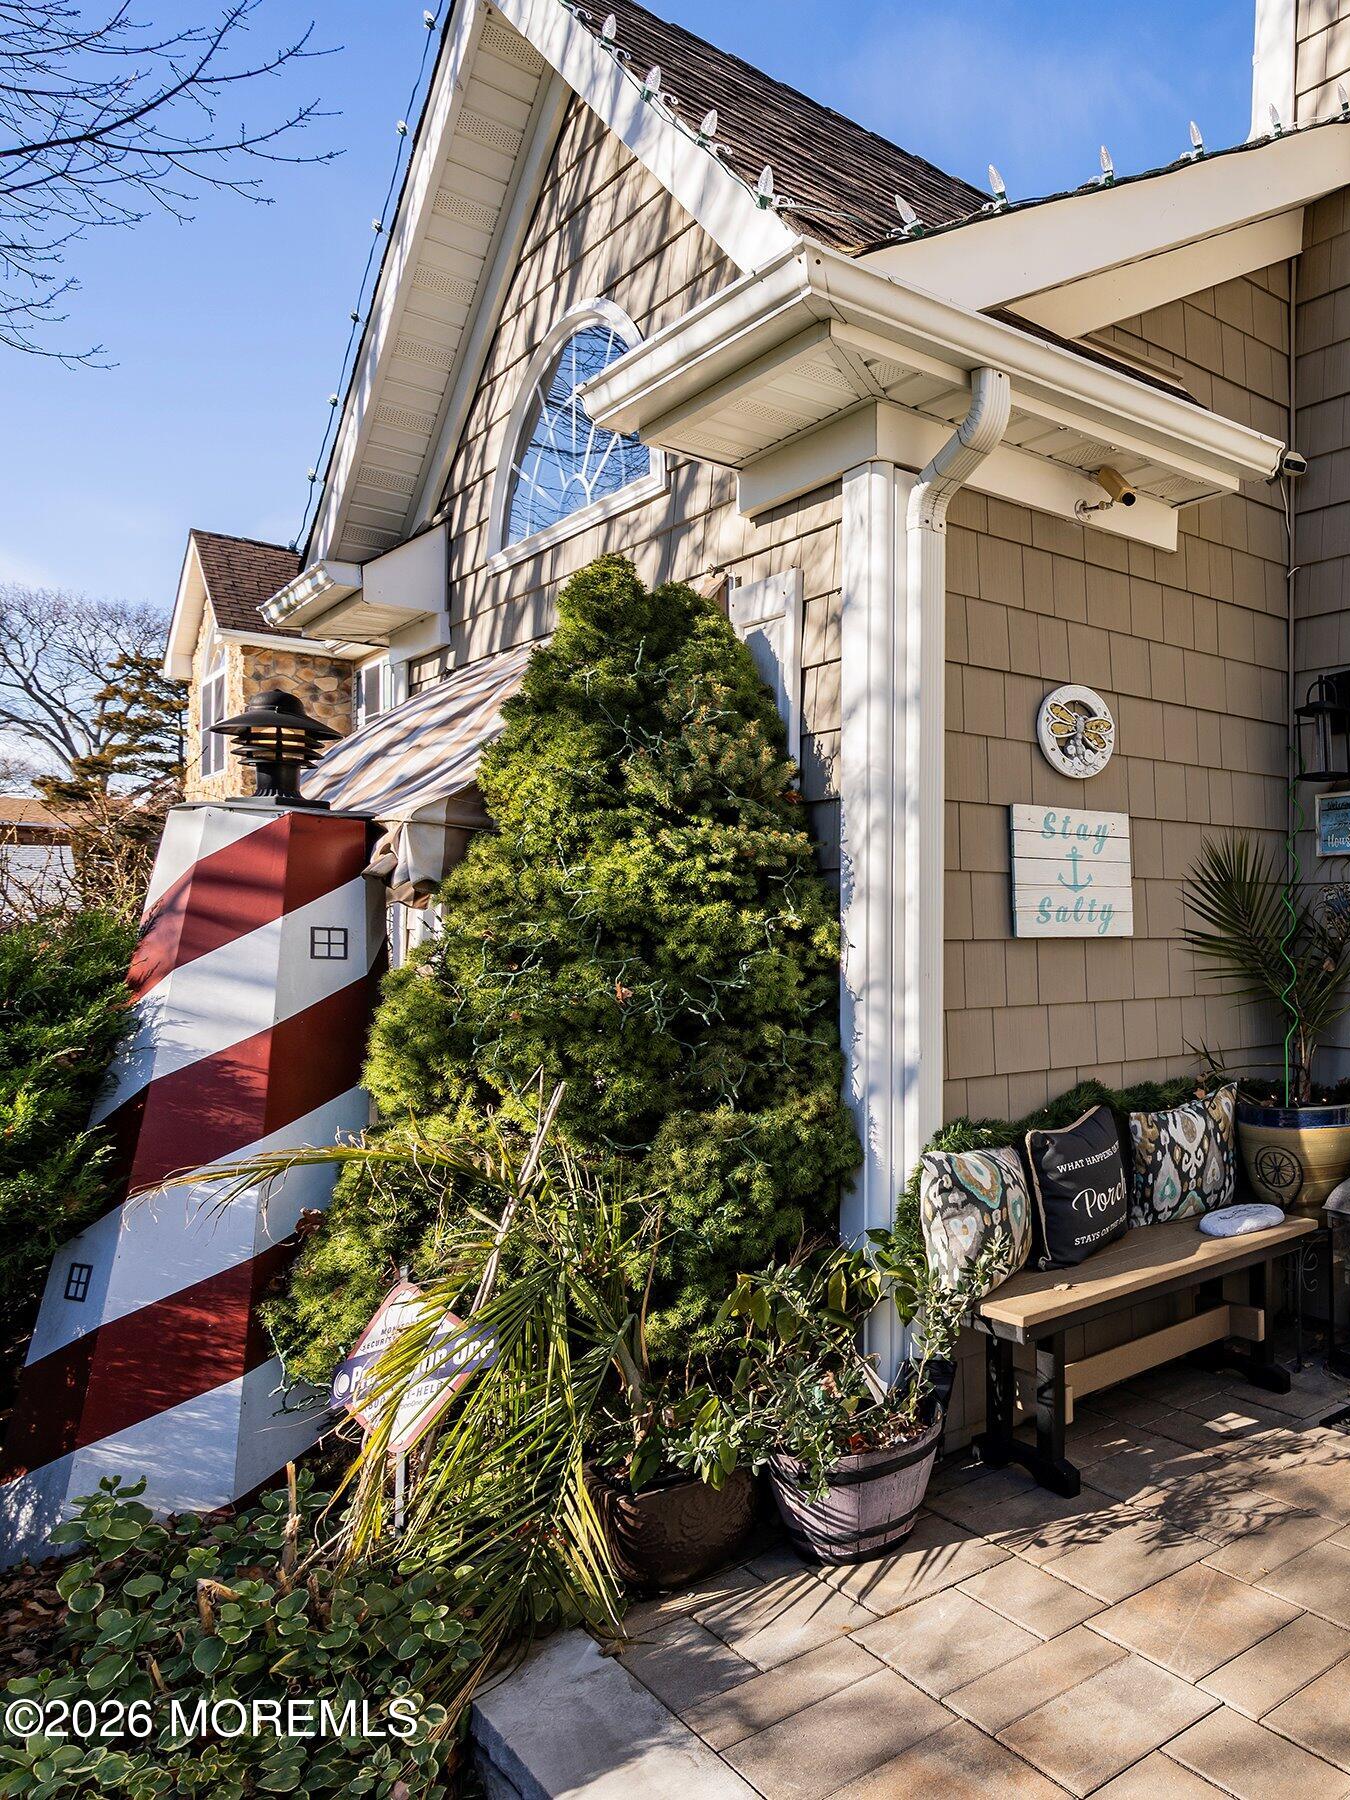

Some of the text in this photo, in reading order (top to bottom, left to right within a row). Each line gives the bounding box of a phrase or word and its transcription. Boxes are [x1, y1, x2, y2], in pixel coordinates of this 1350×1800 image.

[1040, 811, 1110, 855] Stay
[1036, 896, 1115, 935] Salty
[1056, 1158, 1085, 1174] WHAT
[1085, 1148, 1114, 1166] HAPPENS
[1072, 1167, 1127, 1219] Porch
[1074, 1231, 1101, 1247] STAYS
